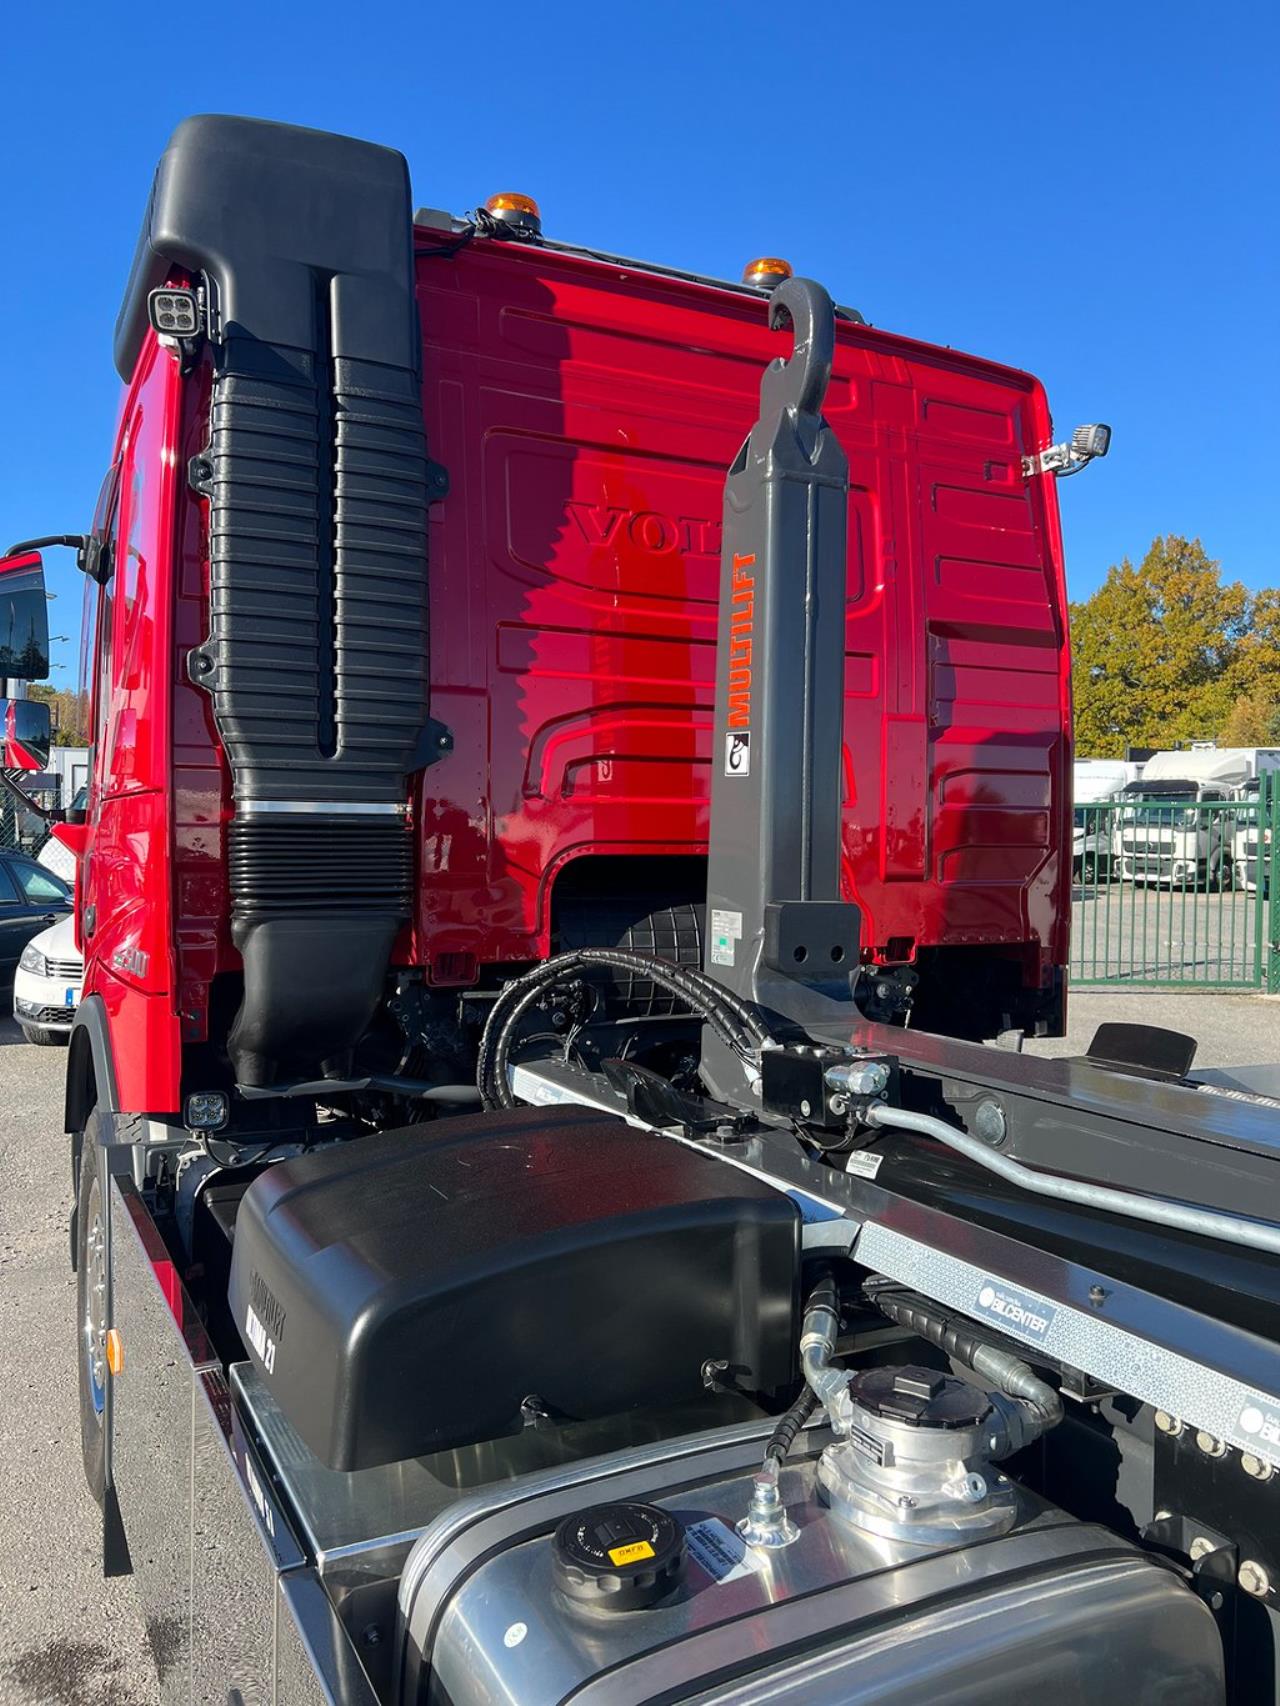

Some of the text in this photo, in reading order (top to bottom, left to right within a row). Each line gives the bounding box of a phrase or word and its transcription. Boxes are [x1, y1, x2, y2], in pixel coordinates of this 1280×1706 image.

[563, 500, 723, 559] VOL
[727, 552, 756, 728] MULTILIFT
[990, 1298, 1048, 1334] BILCENTER
